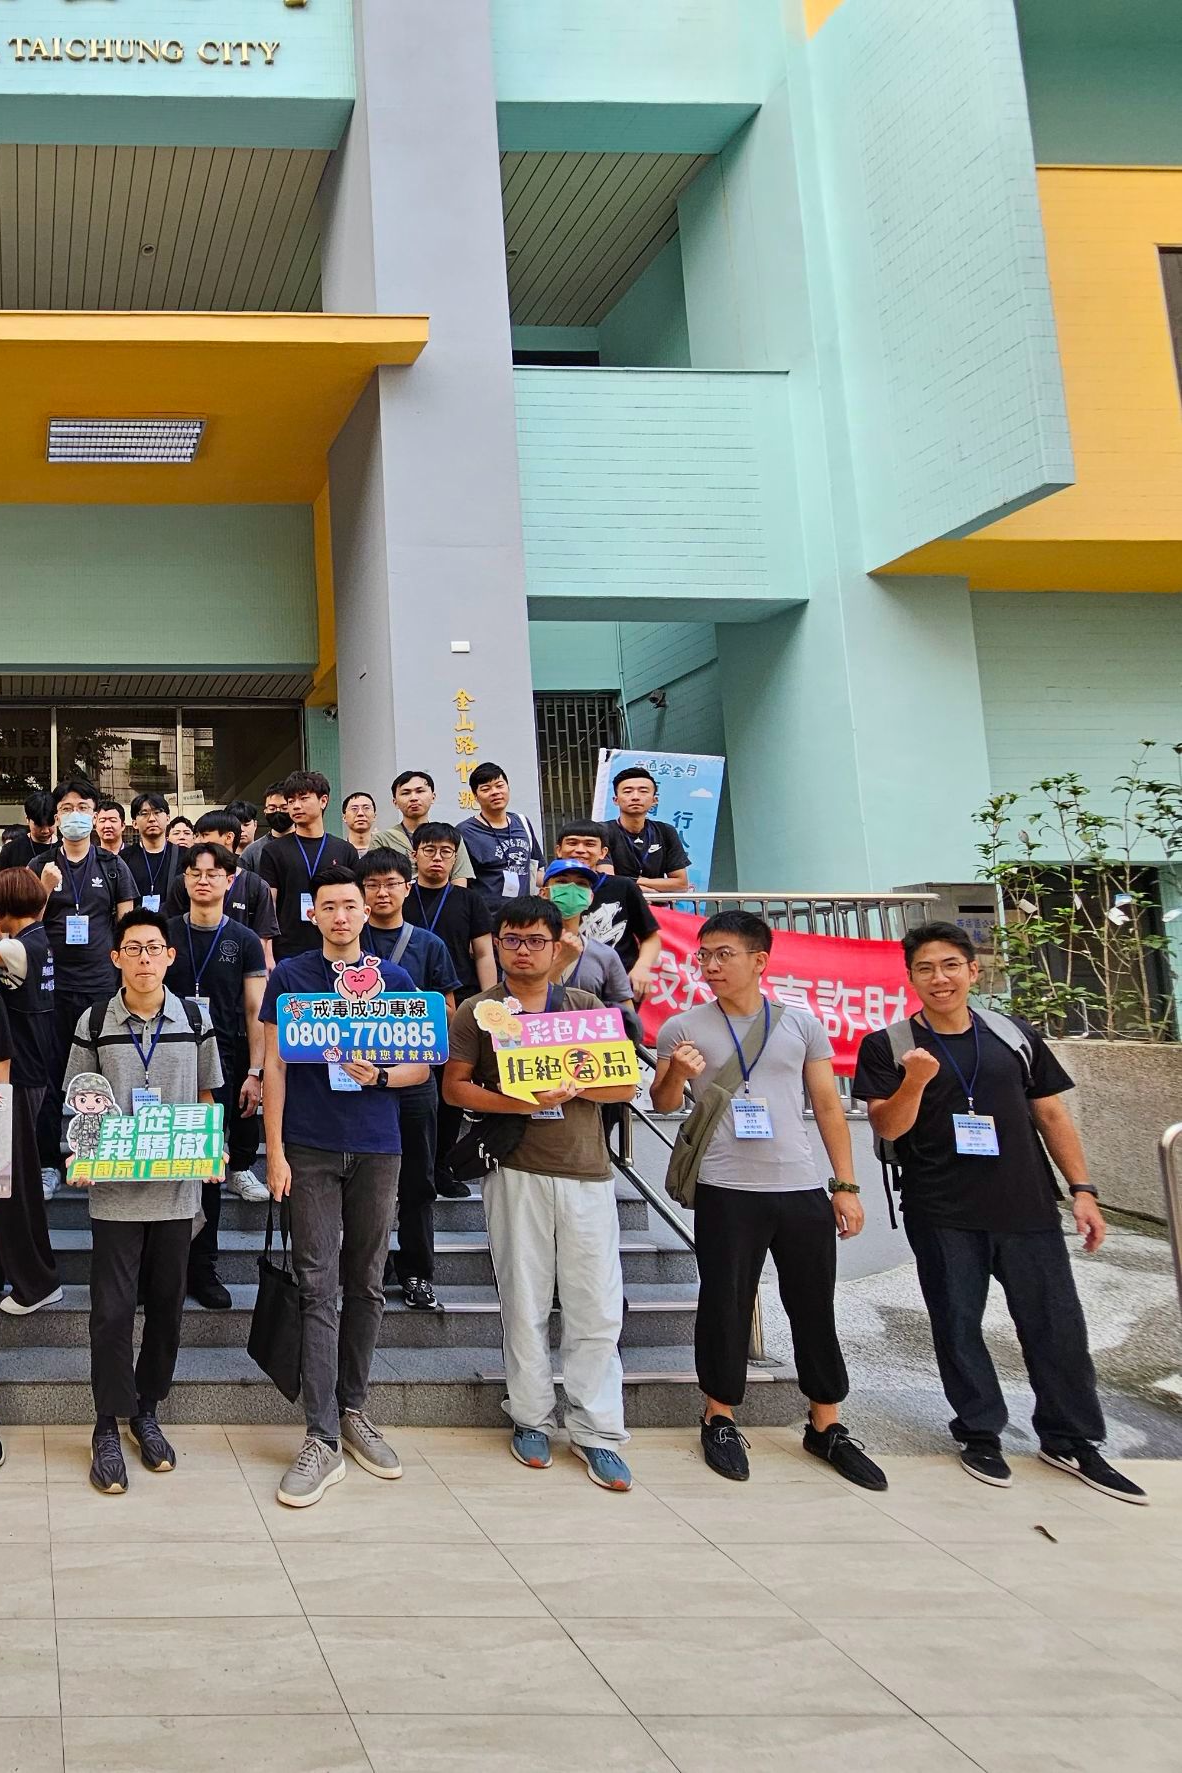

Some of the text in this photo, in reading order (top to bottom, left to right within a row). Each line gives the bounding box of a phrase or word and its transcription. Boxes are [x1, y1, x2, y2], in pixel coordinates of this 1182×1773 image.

[9, 37, 184, 63] TAICHUNG
[198, 41, 280, 65] CITY
[313, 1000, 427, 1018] 戒毒成功專線
[285, 1021, 436, 1047] 0800-770885
[526, 1013, 621, 1044] 彩色人生
[506, 1050, 631, 1084] 拒絕毒品
